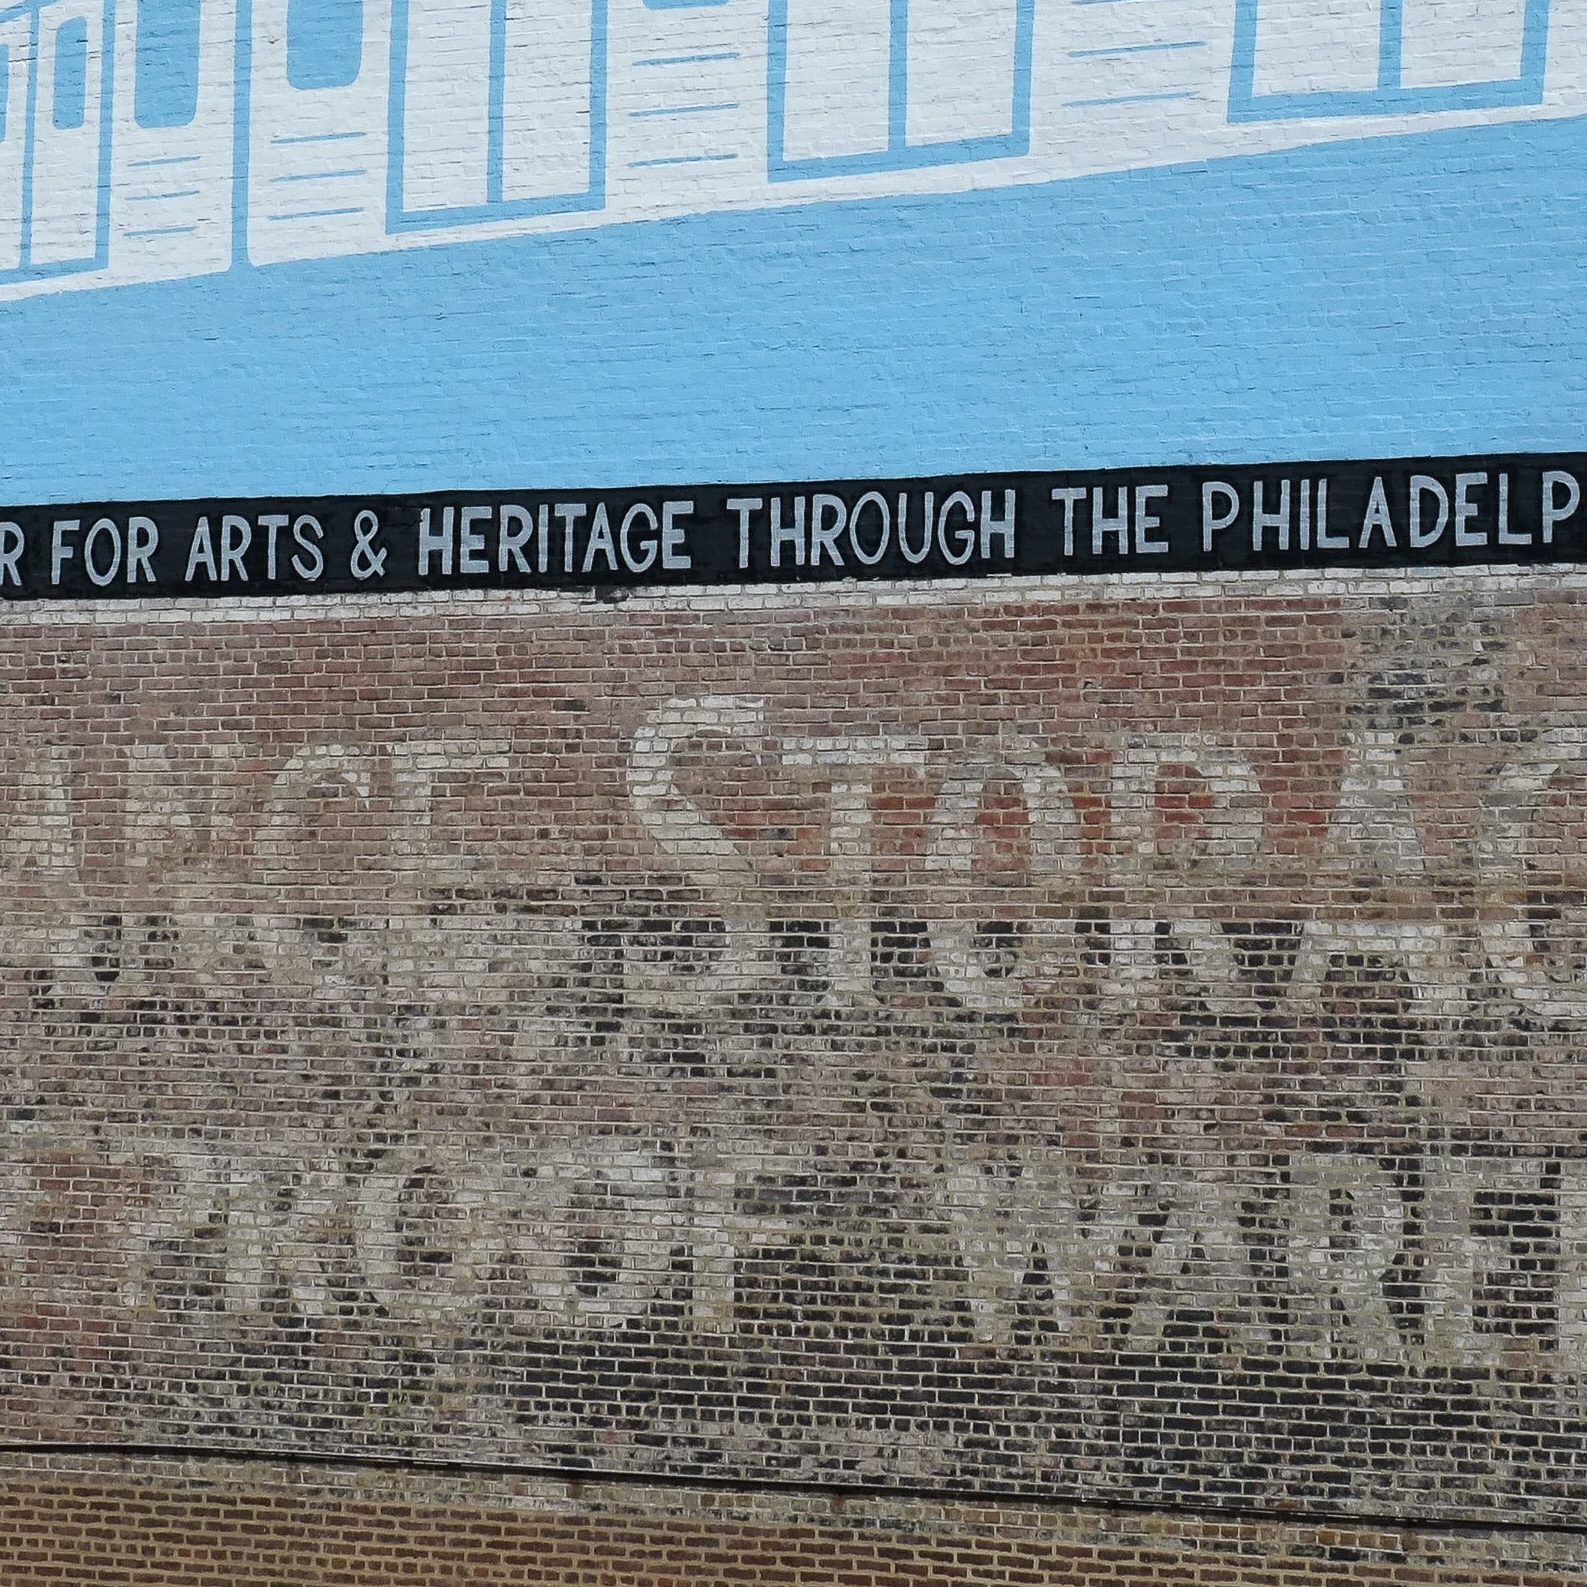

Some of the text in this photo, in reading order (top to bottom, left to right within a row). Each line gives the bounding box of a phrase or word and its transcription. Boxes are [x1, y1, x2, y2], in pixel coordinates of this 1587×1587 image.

[51, 516, 159, 587] FOR
[184, 514, 324, 582] ARTS
[350, 509, 388, 579] &
[419, 500, 694, 576] HERITAGE
[726, 488, 1016, 569] THROUGH
[1051, 484, 1169, 556] THE
